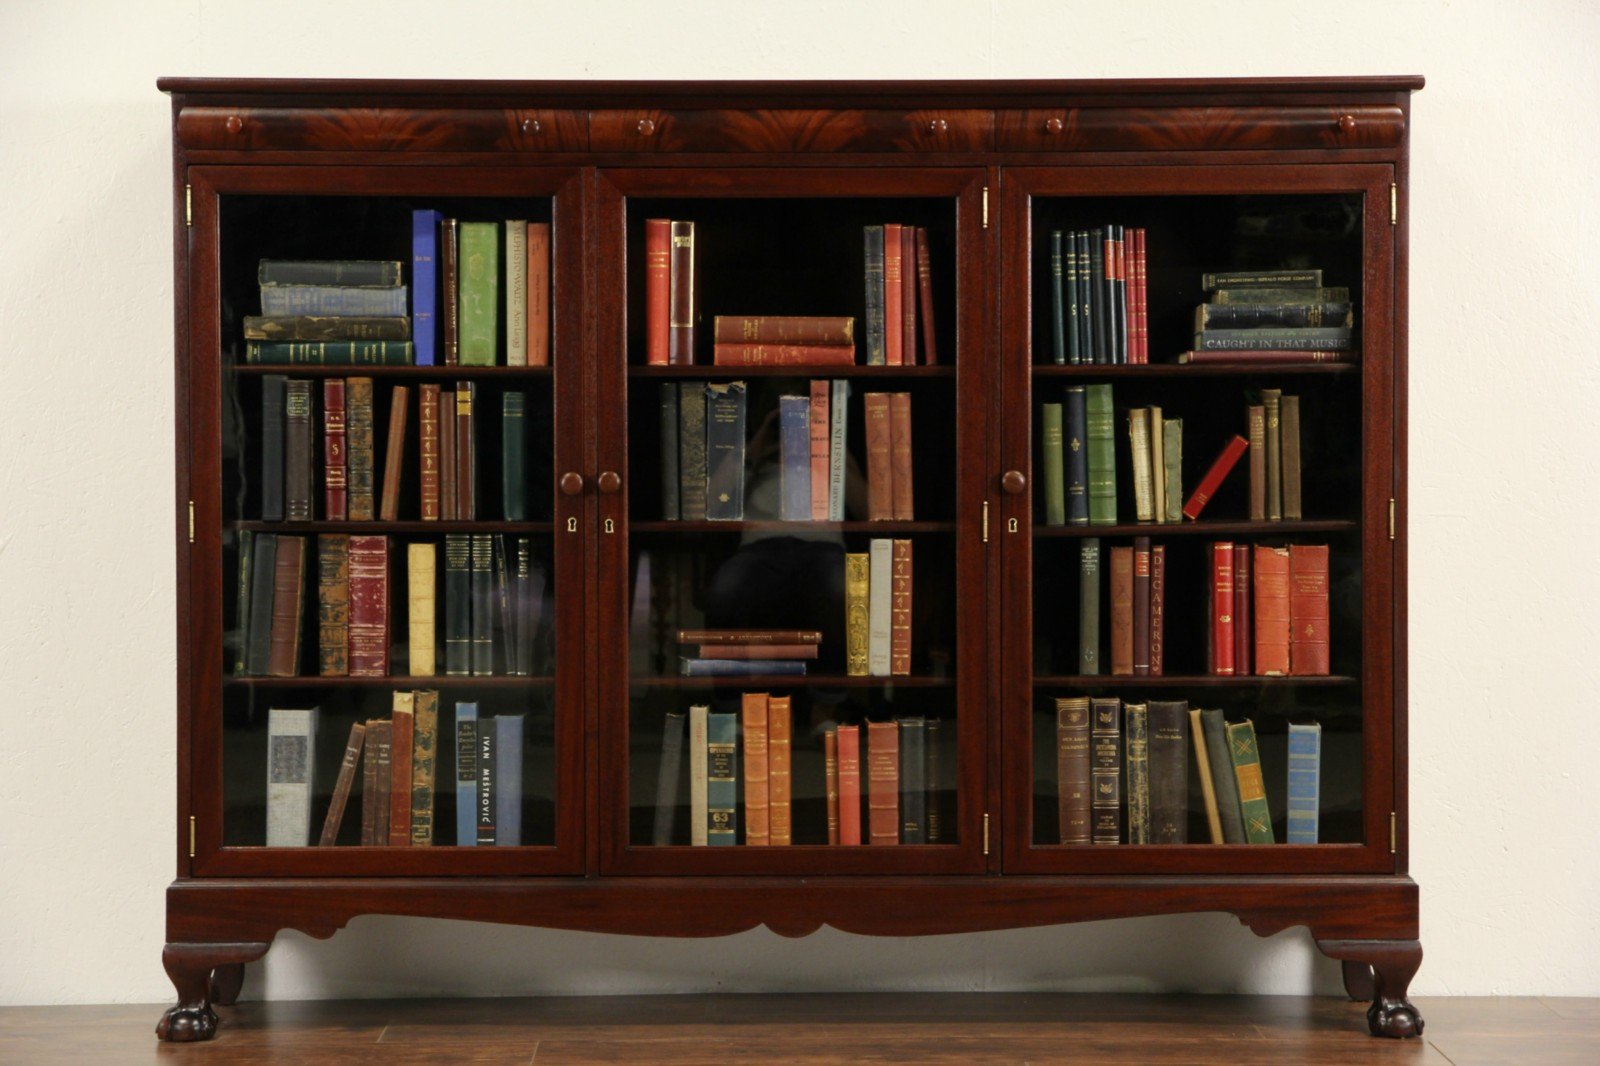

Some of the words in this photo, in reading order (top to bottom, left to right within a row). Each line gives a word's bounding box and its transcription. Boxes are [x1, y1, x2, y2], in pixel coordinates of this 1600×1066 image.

[1206, 339, 1256, 348] CAUGHT
[1259, 339, 1272, 348] IN
[1275, 339, 1307, 348] THAT
[1310, 338, 1347, 348] MUSIC
[833, 427, 842, 484] BERNSTEIN
[1151, 556, 1163, 665] DECAMERON
[482, 736, 490, 759] IVAN
[712, 812, 729, 823] 63
